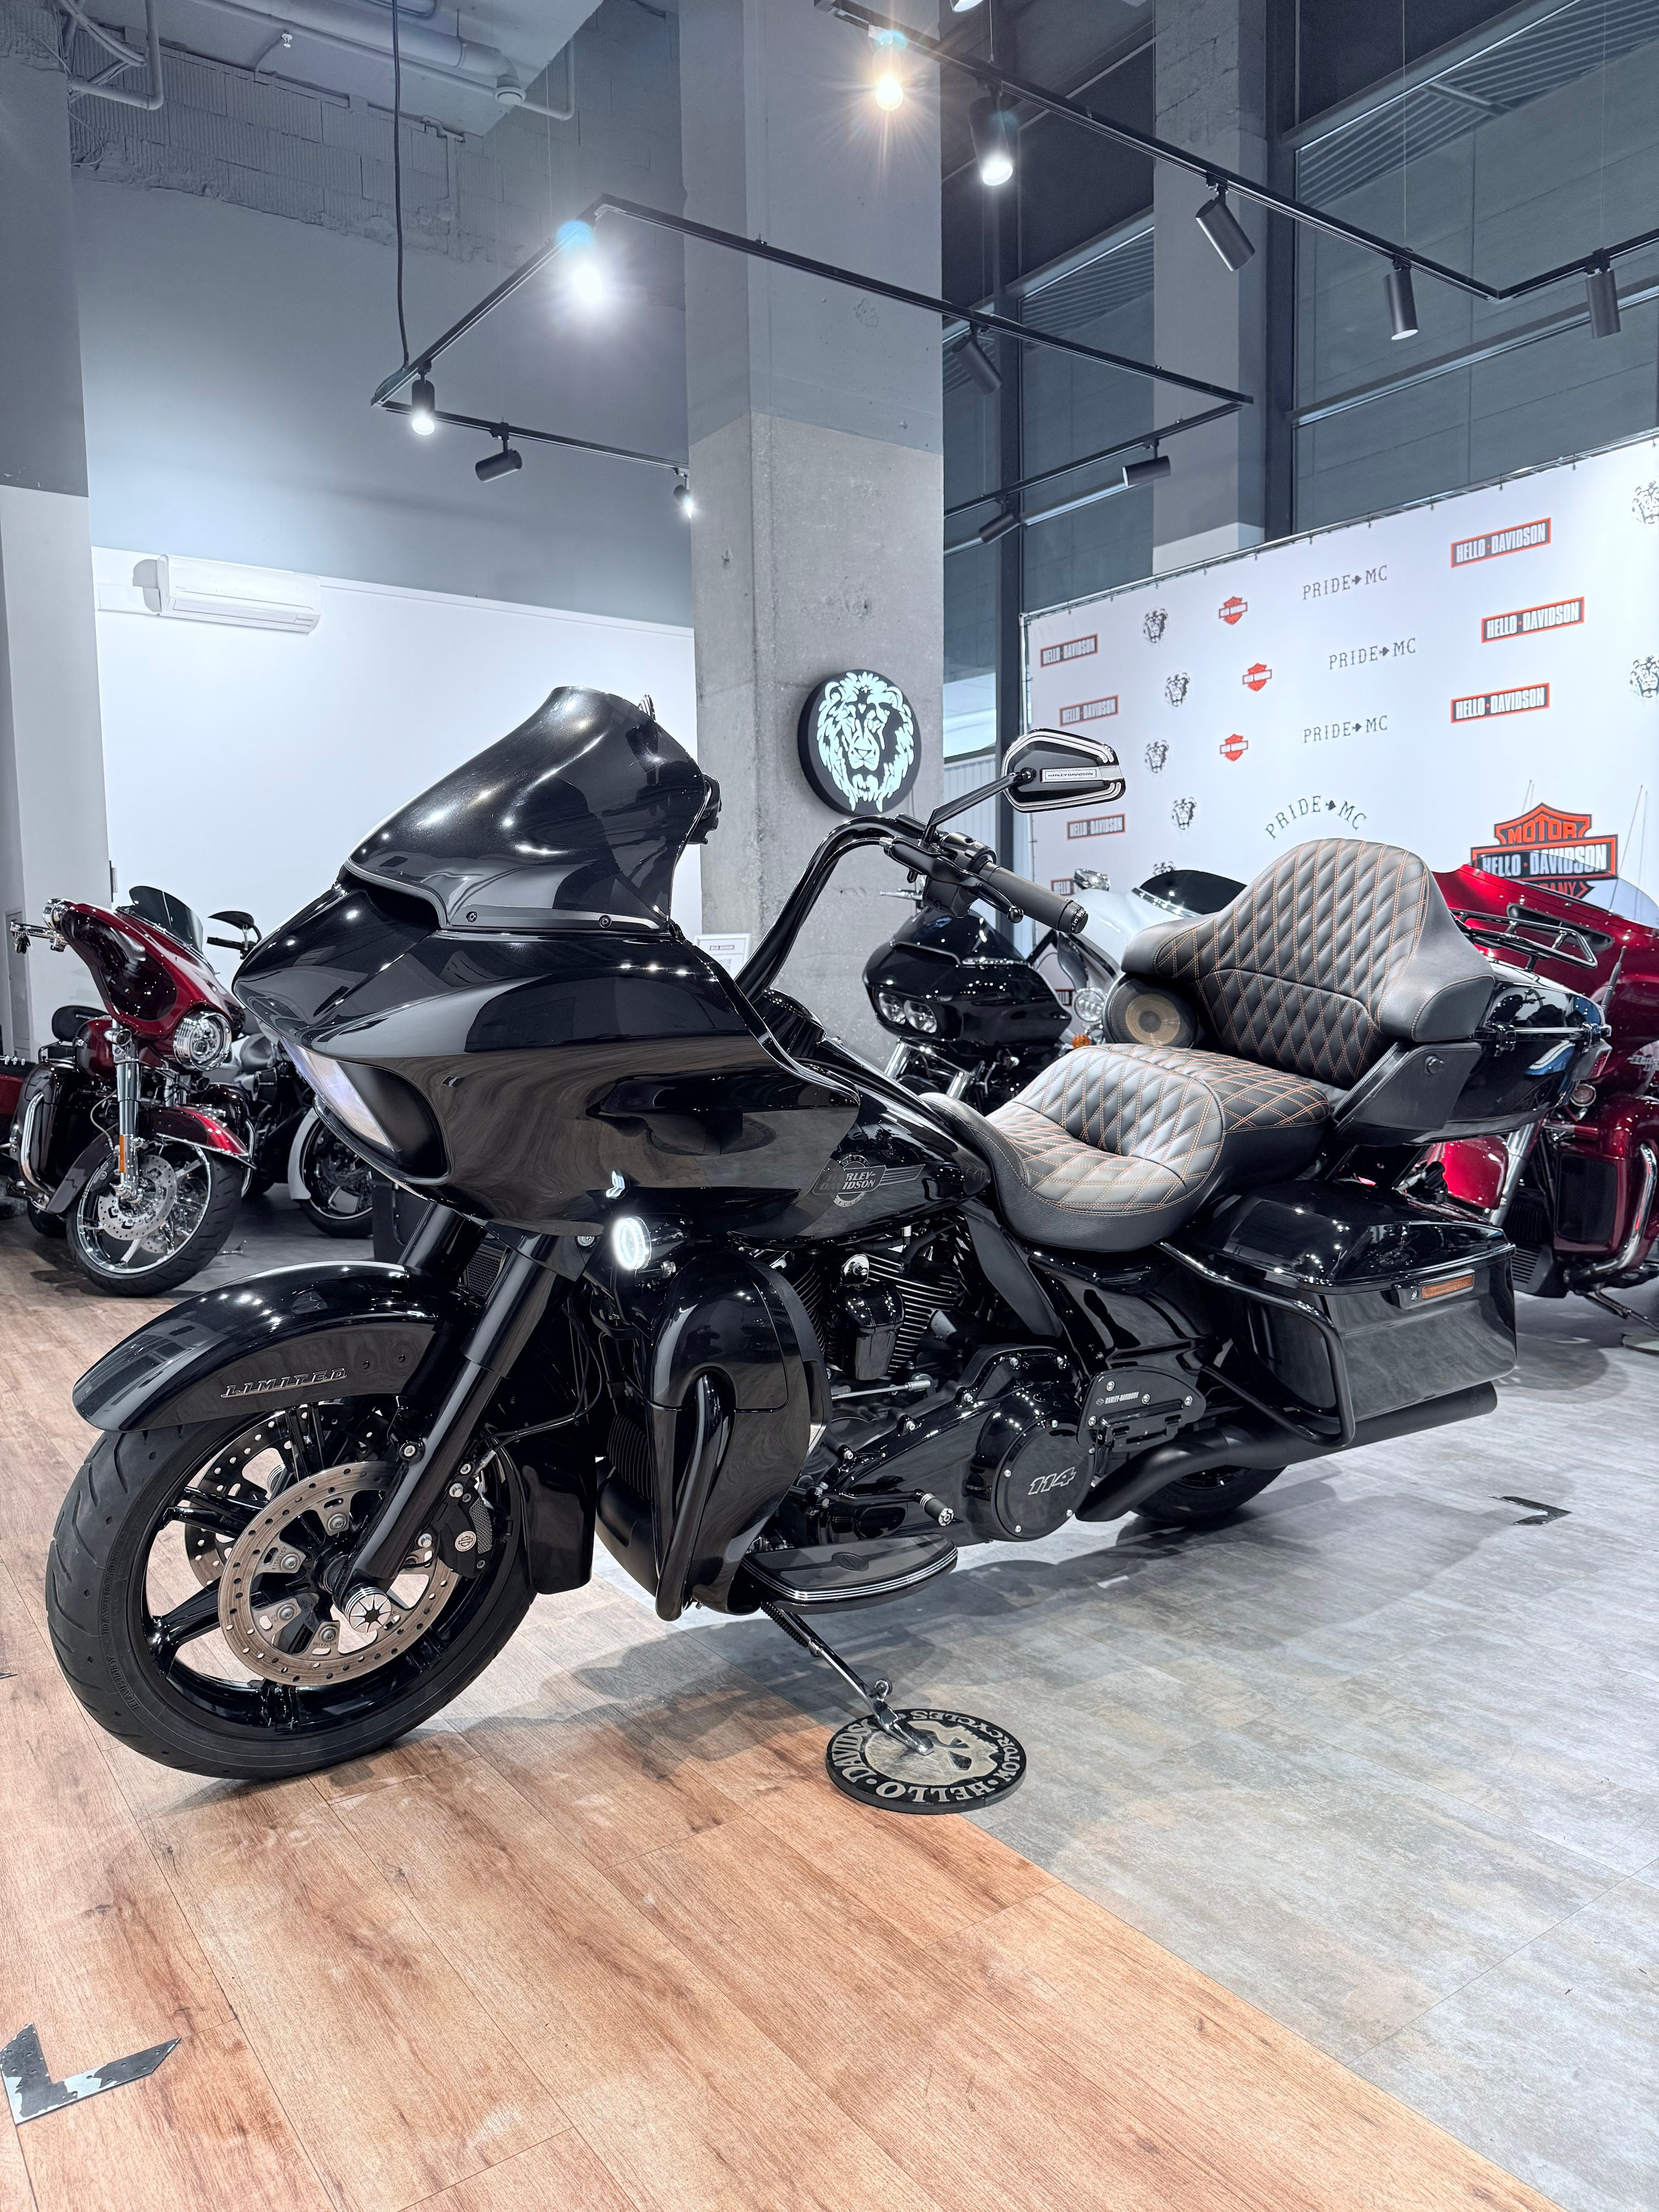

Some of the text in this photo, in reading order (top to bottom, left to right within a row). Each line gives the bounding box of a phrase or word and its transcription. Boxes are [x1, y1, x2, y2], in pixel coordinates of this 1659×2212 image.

[1456, 522, 1546, 563] HELLO DAVIDSON
[1303, 565, 1387, 601] PRIDE MC
[1487, 601, 1580, 639] HELLO DAVIDSON
[1042, 636, 1096, 665] HELLO DAVIDSON
[1328, 637, 1417, 670] PRIDE MC
[1062, 698, 1116, 725] HELLO DAVIDSON
[1456, 687, 1546, 721] HELLO DAVIDSON
[1303, 715, 1388, 743] PRIDE MC
[1069, 821, 1087, 838] HELLO
[1265, 795, 1368, 840] PRIDE MC
[1508, 814, 1577, 844] MOTOR
[1482, 844, 1608, 878] HELLO DAVIDSON
[220, 1368, 347, 1398] LIMITED
[1027, 1466, 1077, 1496] 114
[910, 1710, 1020, 1782] MOTORCYCLES
[876, 1780, 996, 1803] HELLO
